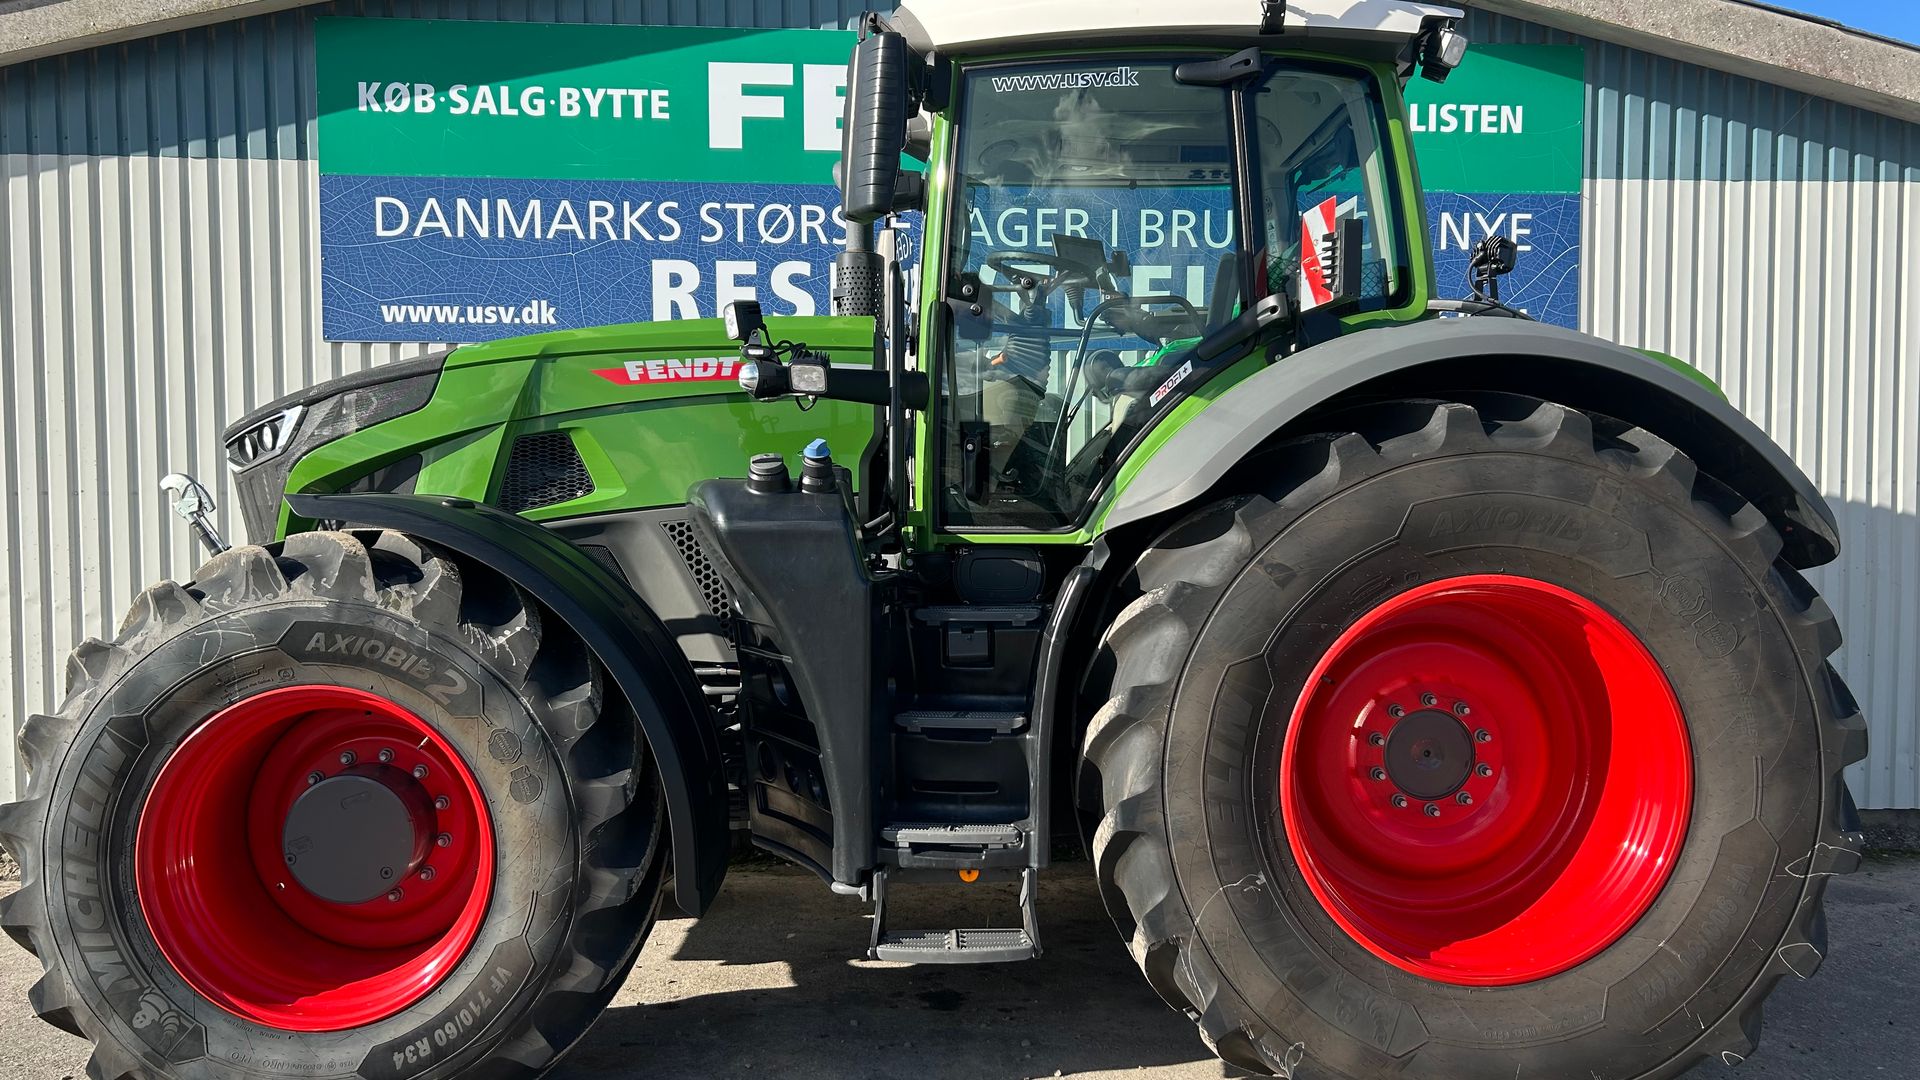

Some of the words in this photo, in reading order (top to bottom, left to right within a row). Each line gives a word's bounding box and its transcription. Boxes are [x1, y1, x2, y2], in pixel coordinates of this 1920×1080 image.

[991, 66, 1140, 93] www.usv.dk
[707, 61, 849, 152] FE
[1410, 103, 1523, 134] LISTEN
[374, 196, 682, 243] DANMARKS
[968, 206, 1090, 248] AGER
[1111, 208, 1119, 248] I
[1139, 208, 1236, 249] BRU
[1440, 211, 1533, 251] NYE
[380, 300, 558, 325] www.usv.dk
[623, 356, 741, 382] FENDT
[1154, 370, 1182, 402] PROFI
[304, 631, 436, 681] AXIOBIB
[423, 668, 468, 706] 2
[64, 731, 142, 992] MICHELIN
[489, 965, 513, 995] VF
[433, 990, 493, 1047] 710/60
[392, 1036, 432, 1071] R34
